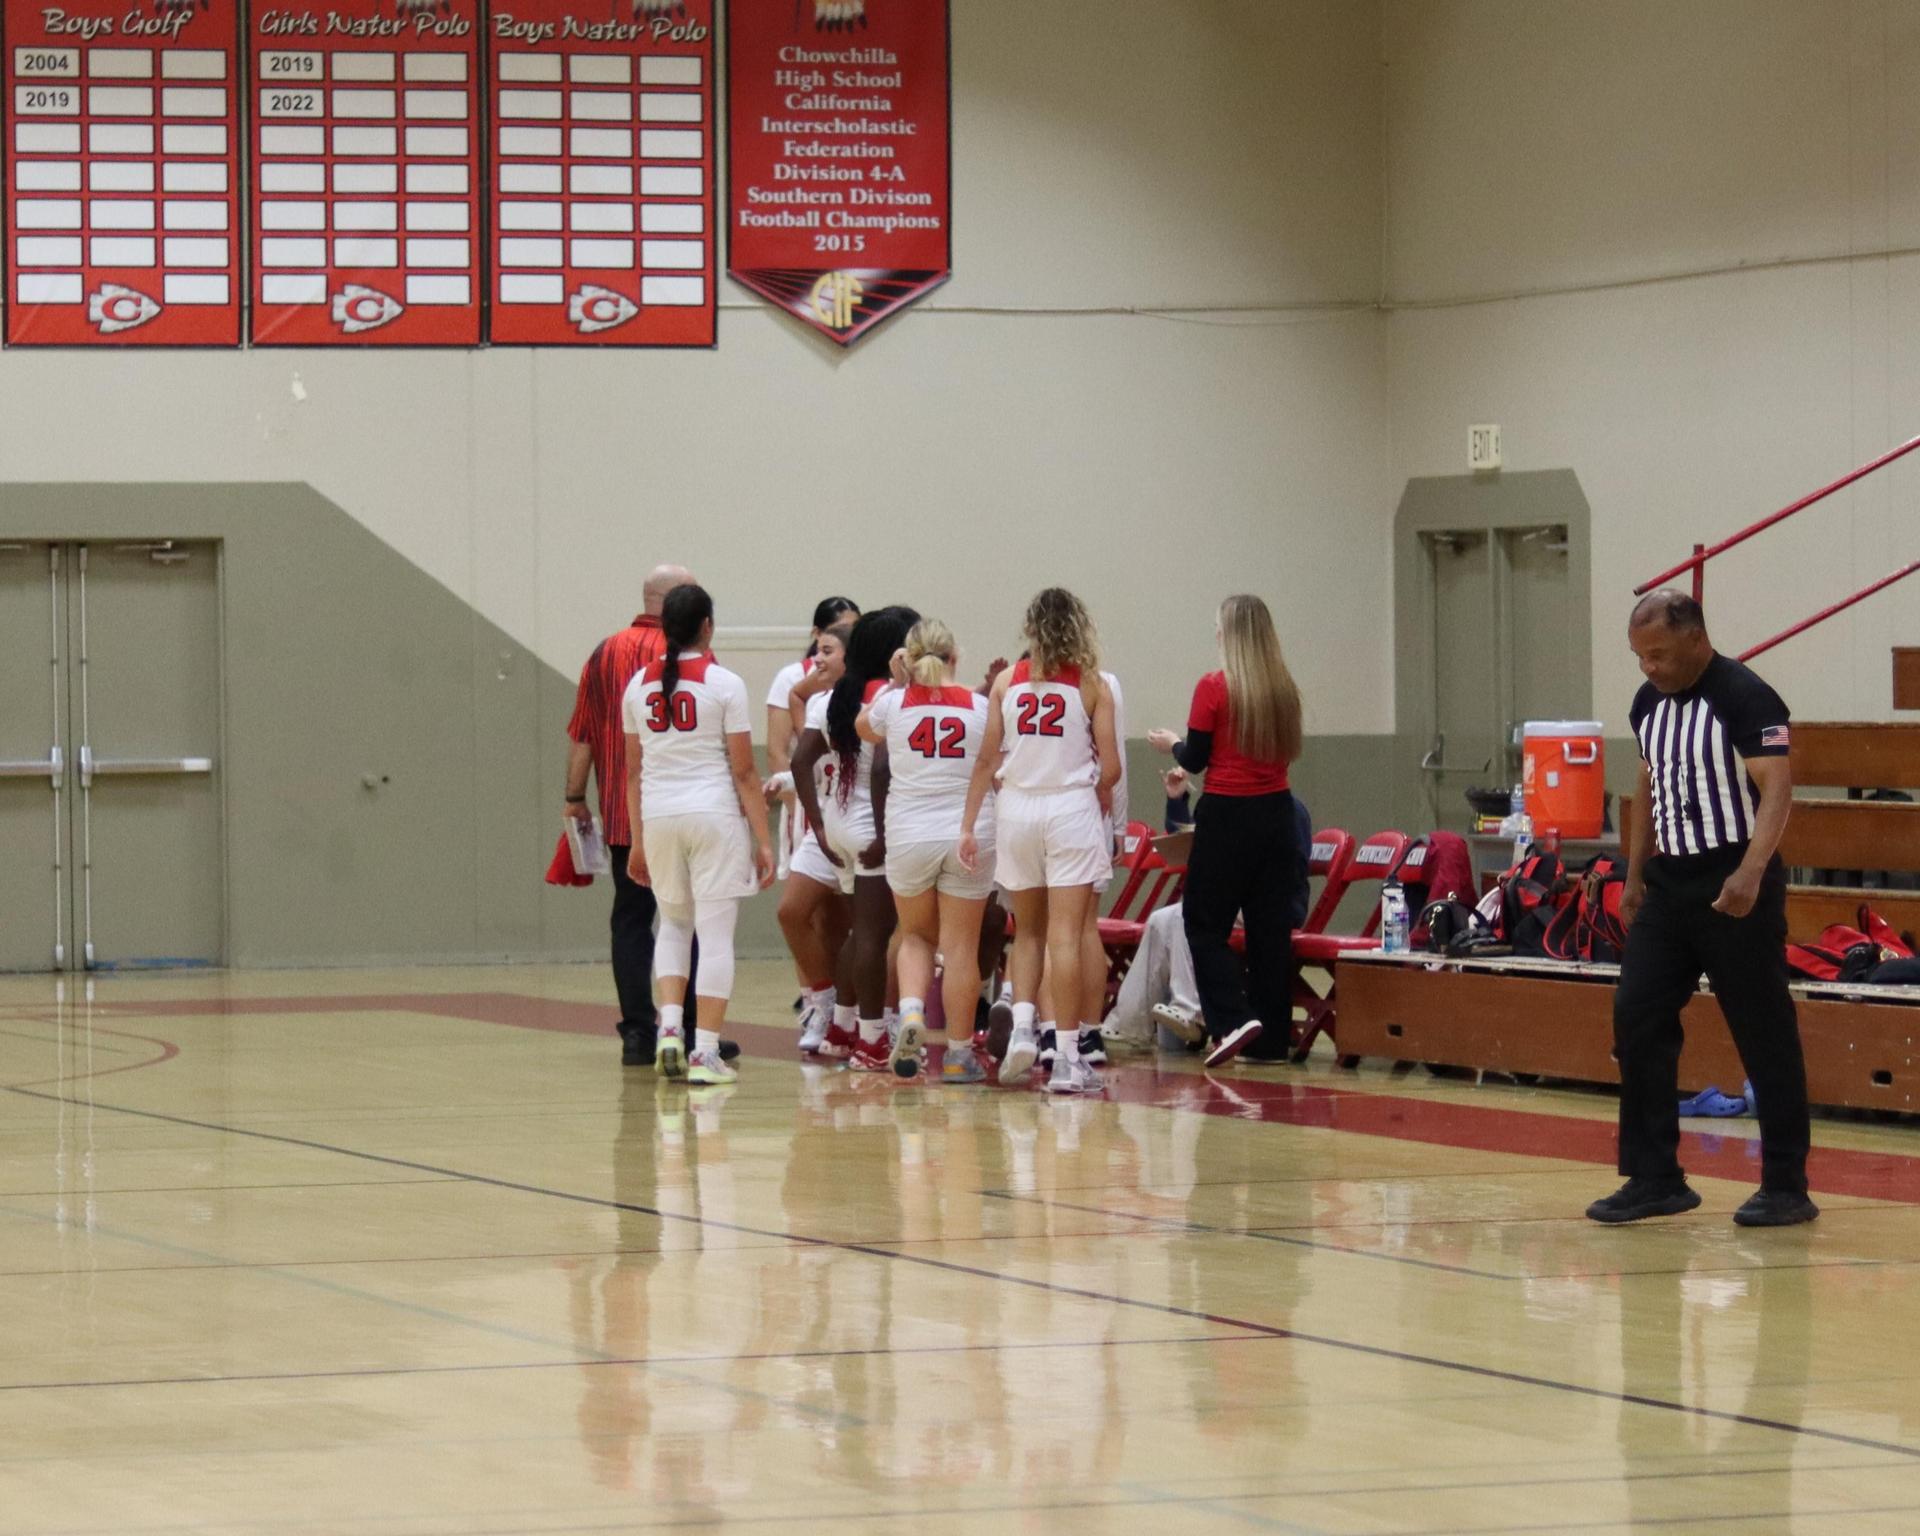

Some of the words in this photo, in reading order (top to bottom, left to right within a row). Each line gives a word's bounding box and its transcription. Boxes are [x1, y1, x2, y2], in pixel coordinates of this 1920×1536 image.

[42, 8, 113, 40] Boys
[121, 9, 193, 42] Golf
[260, 10, 318, 34] Girls
[325, 11, 407, 36] Water
[413, 12, 470, 41] Polo
[493, 13, 554, 44] Boys
[561, 15, 644, 40] Water
[651, 17, 707, 43] Polo
[24, 55, 69, 71] 2004
[779, 46, 897, 64] Chowchilla
[270, 57, 313, 73] 2019
[775, 70, 826, 91] High
[832, 71, 902, 88] School
[26, 92, 69, 108] 2019
[271, 95, 313, 111] 2022
[785, 93, 891, 111] California
[761, 116, 916, 135] Interscholastic
[784, 140, 894, 158] Federation
[774, 163, 863, 181] Division
[869, 165, 905, 181] 4-A
[748, 186, 843, 204] Southern
[849, 188, 932, 205] Divison
[739, 210, 820, 228] Football
[826, 211, 940, 234] Champions
[815, 235, 865, 251] 2015
[646, 691, 698, 733] 30
[1016, 692, 1066, 736] 22
[908, 716, 965, 758] 42
